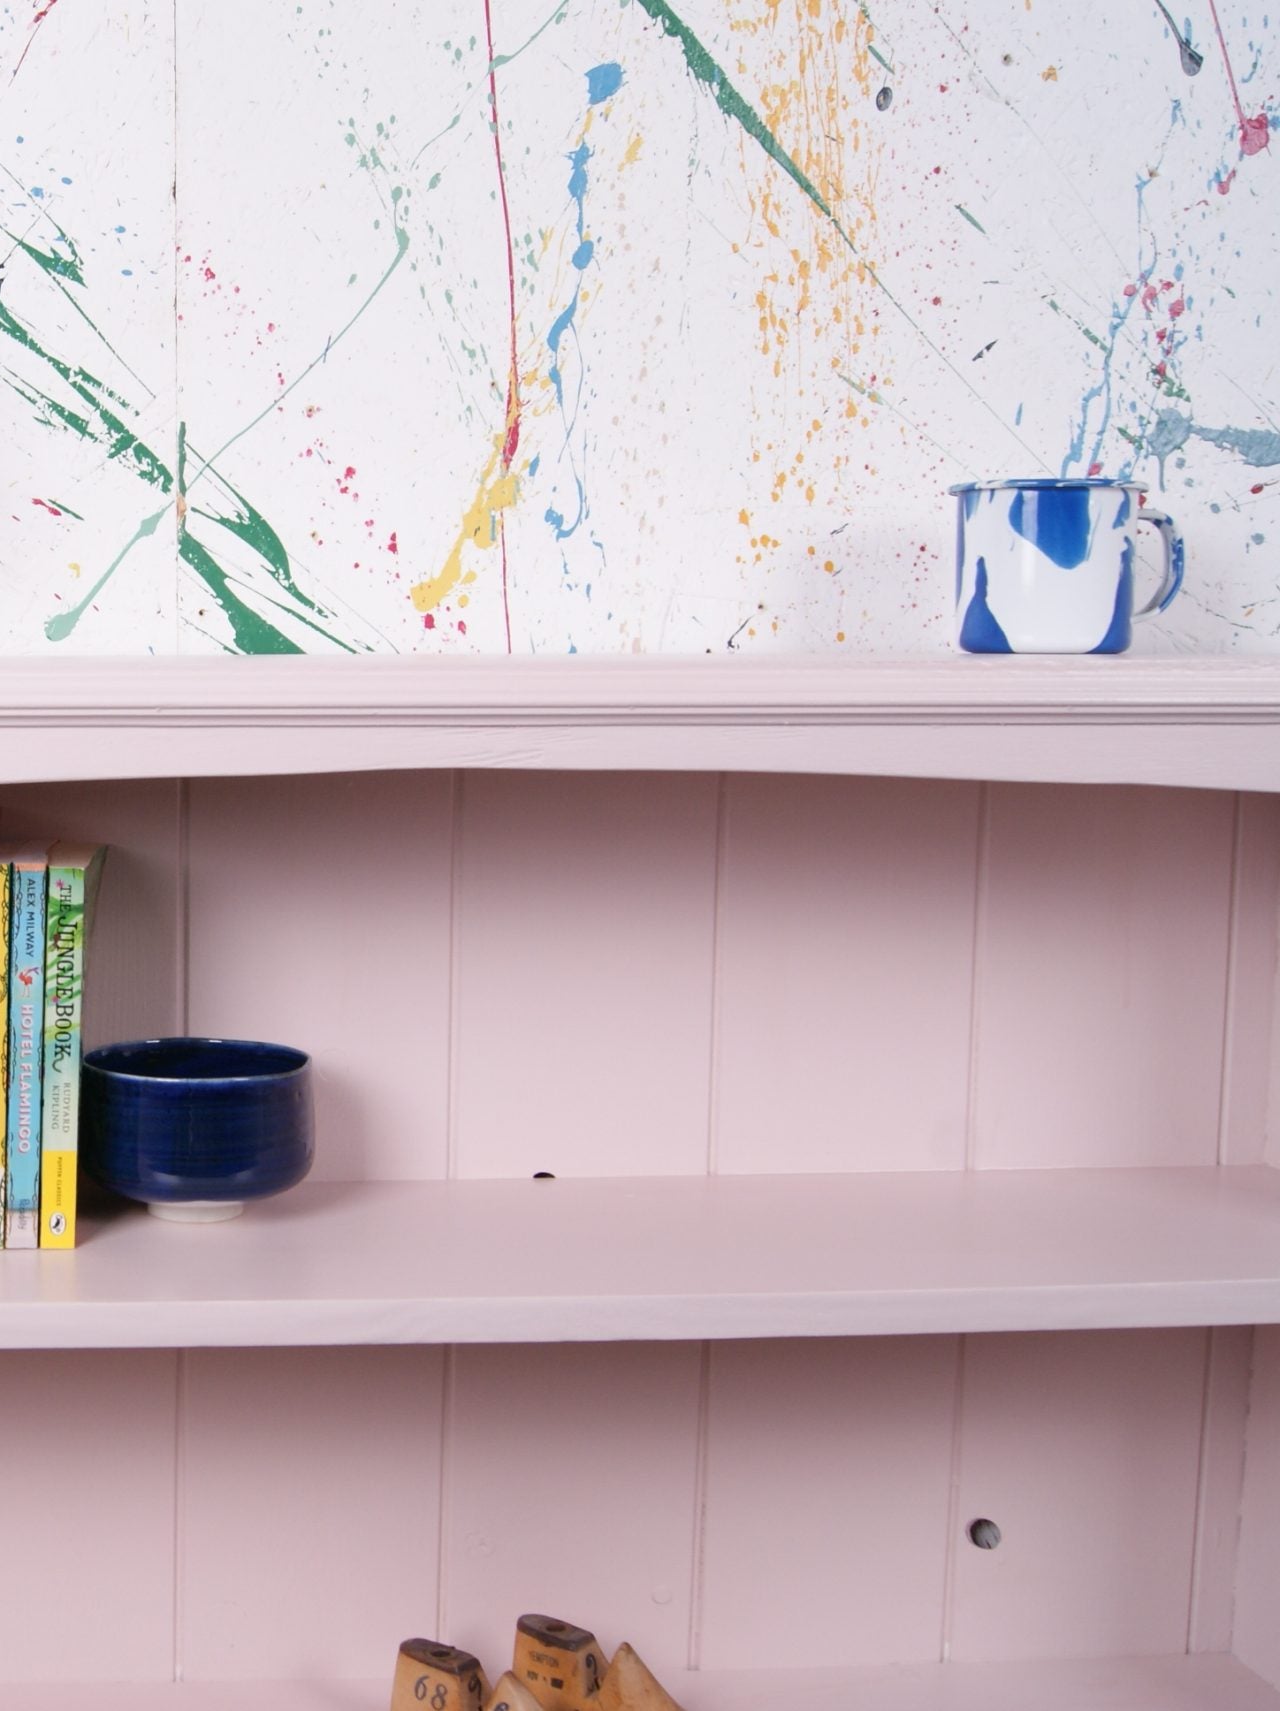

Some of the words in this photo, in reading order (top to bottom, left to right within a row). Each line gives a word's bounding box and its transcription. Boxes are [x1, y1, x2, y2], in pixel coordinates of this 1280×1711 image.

[26, 878, 36, 908] ALEX
[60, 885, 72, 915] THE
[26, 911, 35, 958] MILWAY
[56, 916, 78, 999] JUNGLE
[20, 1006, 33, 1059] HOTEL
[52, 1003, 74, 1073] BOOK
[18, 1064, 32, 1154] FLAMINGO
[51, 1085, 59, 1130] KIPLING
[62, 1082, 71, 1133] RUDYARD
[414, 1675, 448, 1711] 68
